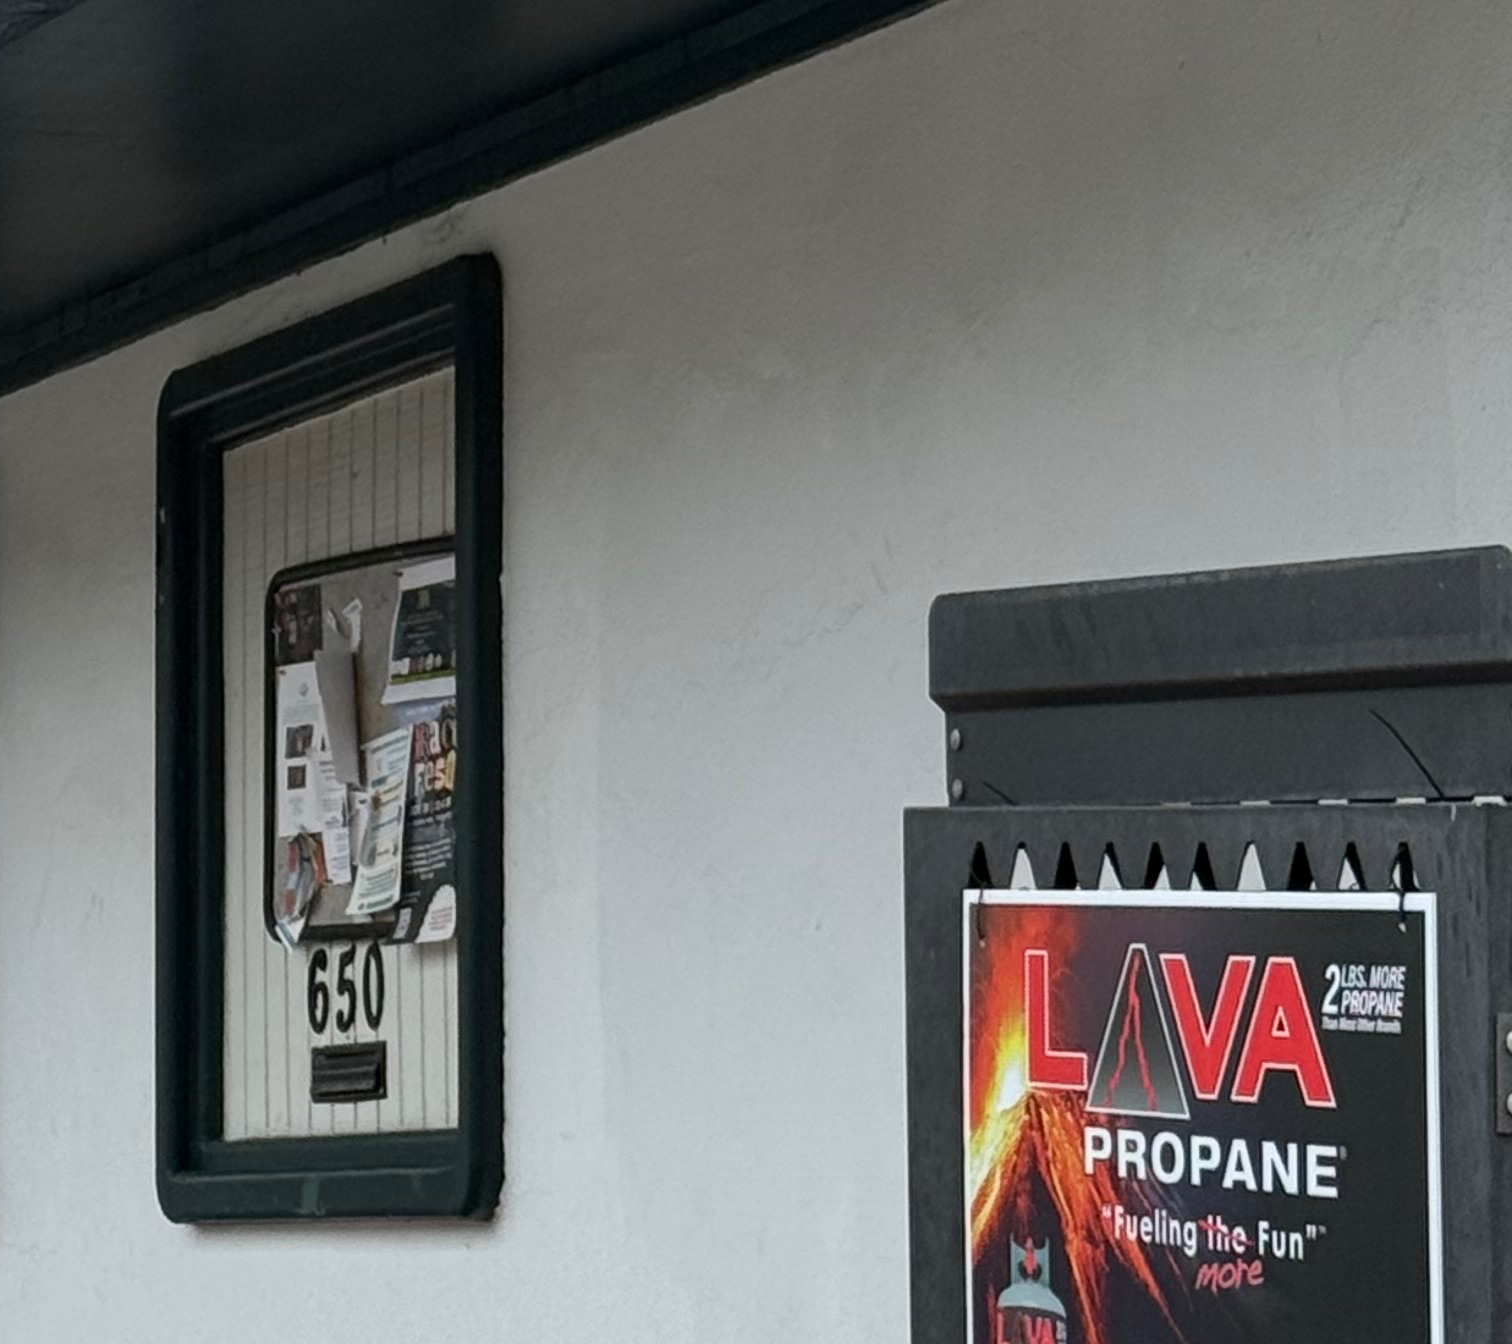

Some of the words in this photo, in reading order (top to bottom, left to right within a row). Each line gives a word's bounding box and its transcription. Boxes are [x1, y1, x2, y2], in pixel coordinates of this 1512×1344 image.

[307, 940, 385, 1035] 650
[1321, 963, 1340, 1015] 2
[1369, 965, 1406, 991] MORE
[1340, 989, 1405, 1018] PROPANE
[1024, 942, 1338, 1119] LAVA
[1083, 1126, 1339, 1198] PROPANE
[1195, 1257, 1265, 1291] more
